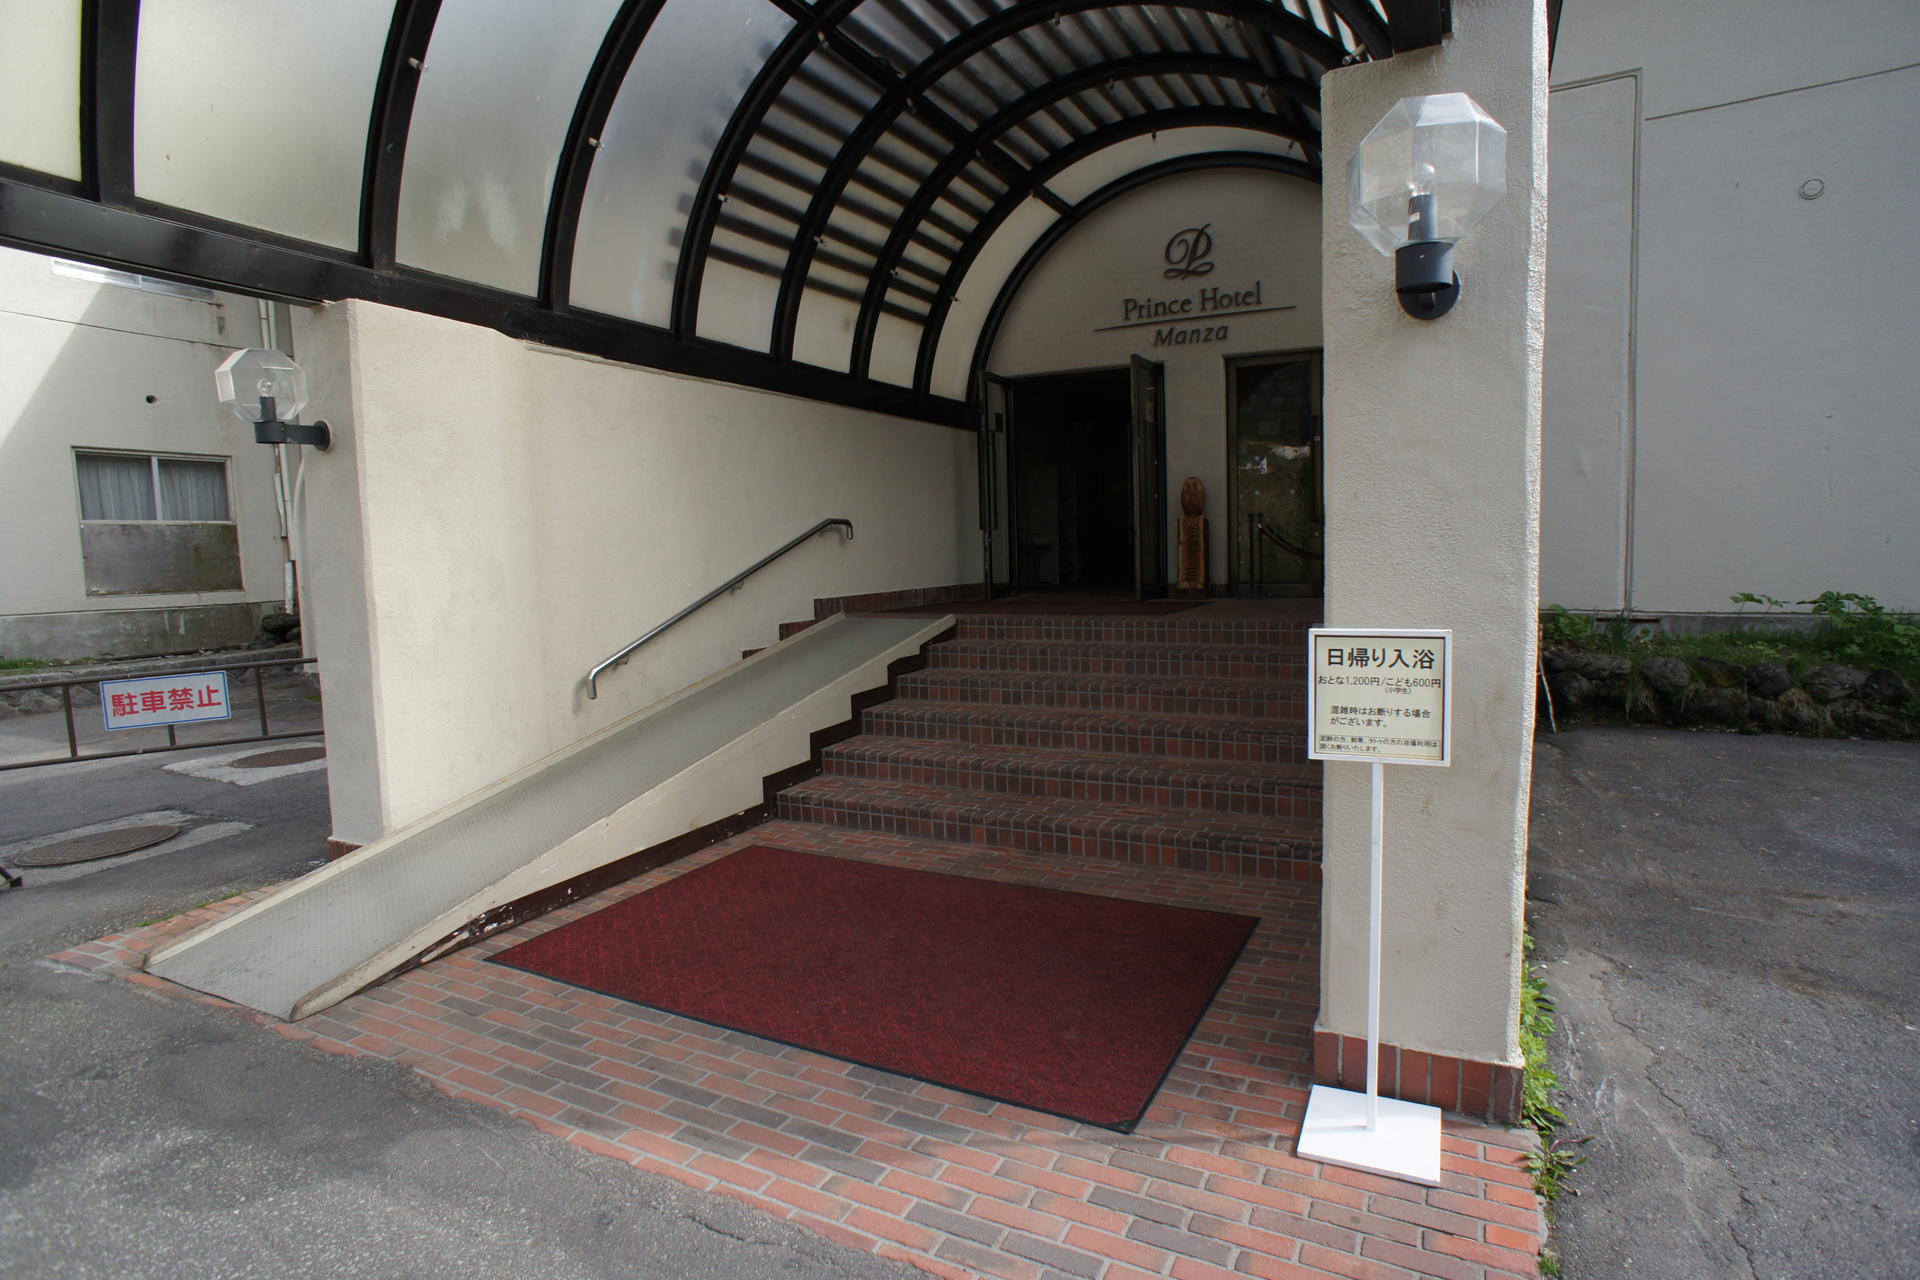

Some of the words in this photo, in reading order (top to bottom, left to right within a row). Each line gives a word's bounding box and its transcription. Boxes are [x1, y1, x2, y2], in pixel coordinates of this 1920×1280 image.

[1123, 298, 1192, 320] Prince
[1200, 280, 1263, 311] Hotel
[1154, 325, 1229, 348] Manza
[1328, 648, 1435, 669] 日帰り入浴
[112, 685, 222, 717] 駐車禁止
[1330, 705, 1431, 718] 混雑時はお断りする場合
[1329, 716, 1388, 728] がございます。
